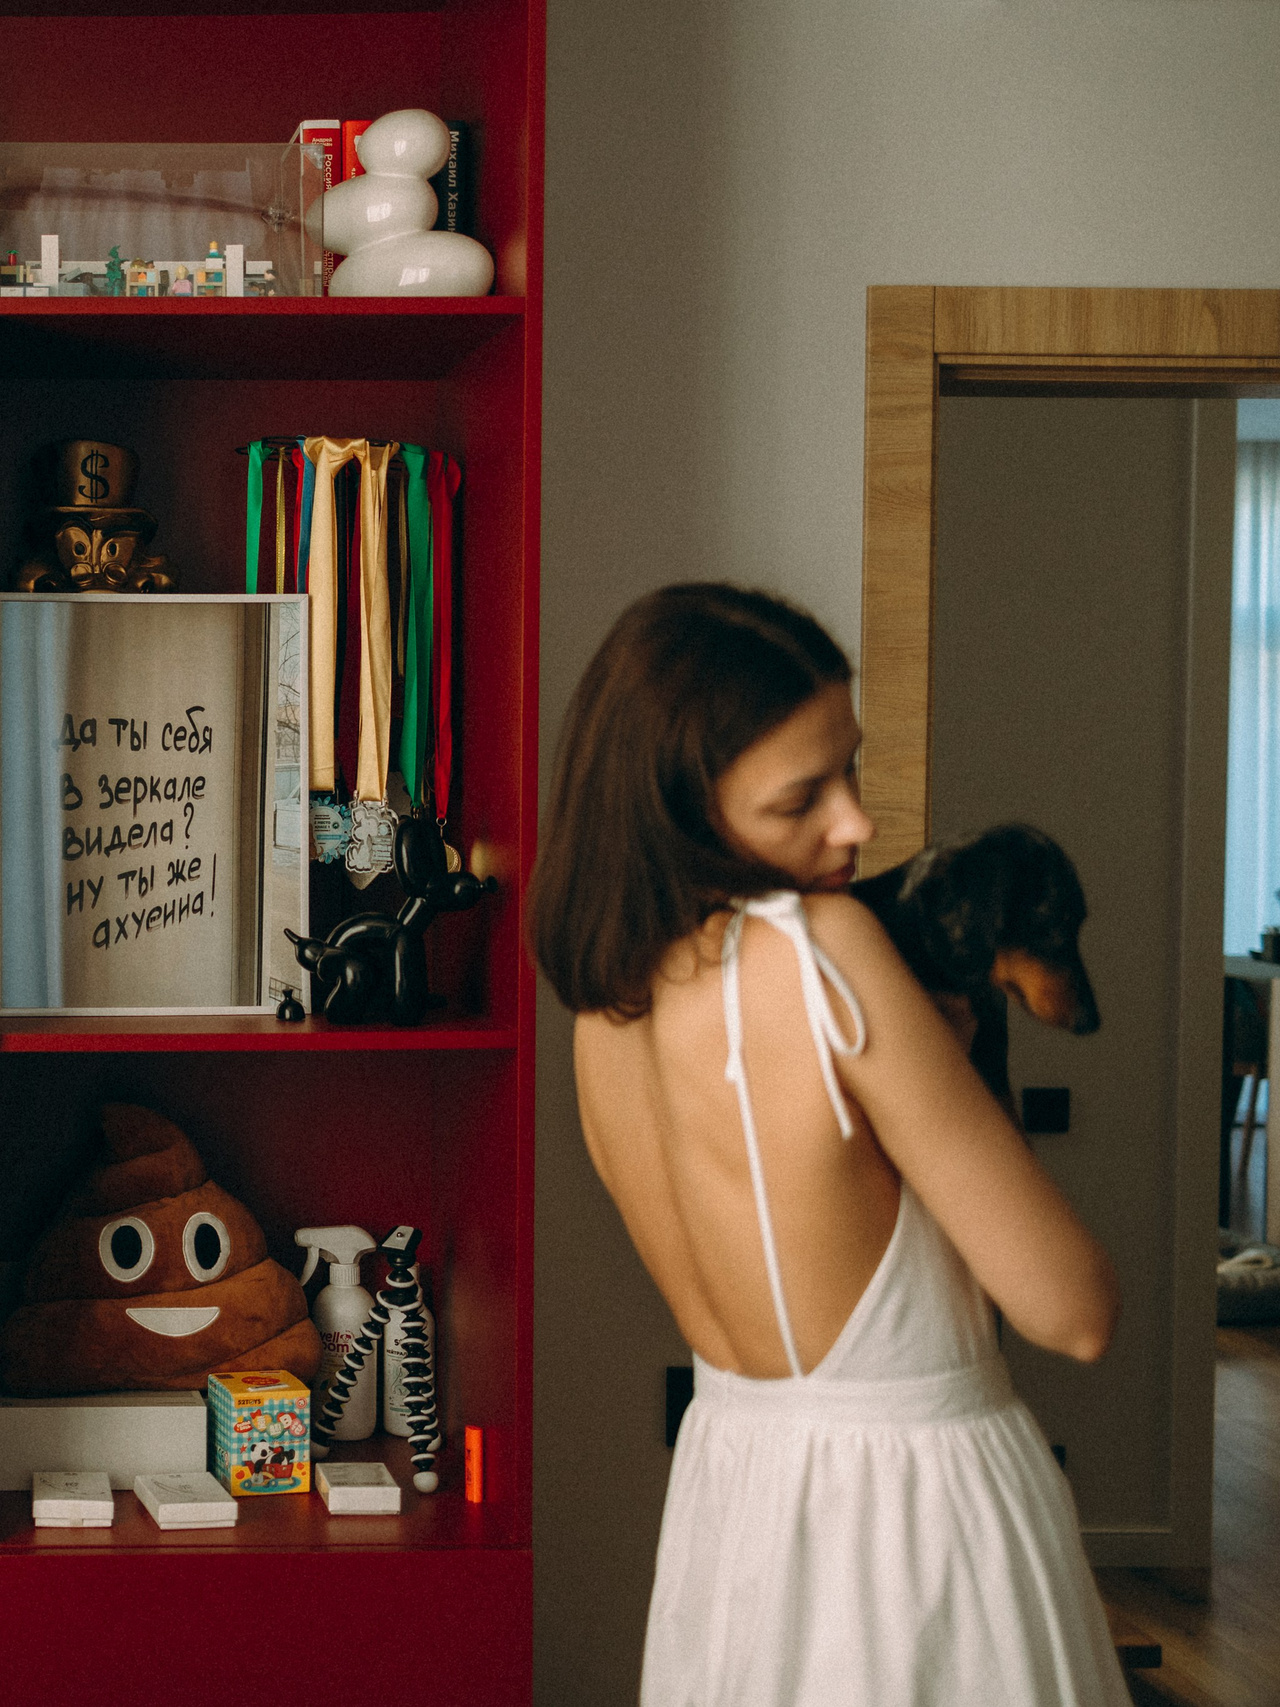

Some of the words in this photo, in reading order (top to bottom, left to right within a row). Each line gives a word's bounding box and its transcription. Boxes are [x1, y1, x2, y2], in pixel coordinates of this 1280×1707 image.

[325, 154, 333, 189] Россия
[448, 131, 459, 187] Михаил
[108, 718, 147, 752] ты
[162, 706, 213, 754] себя
[98, 774, 206, 817] зеркале
[67, 876, 104, 916] ну
[118, 865, 154, 899] ты
[168, 857, 201, 885] же
